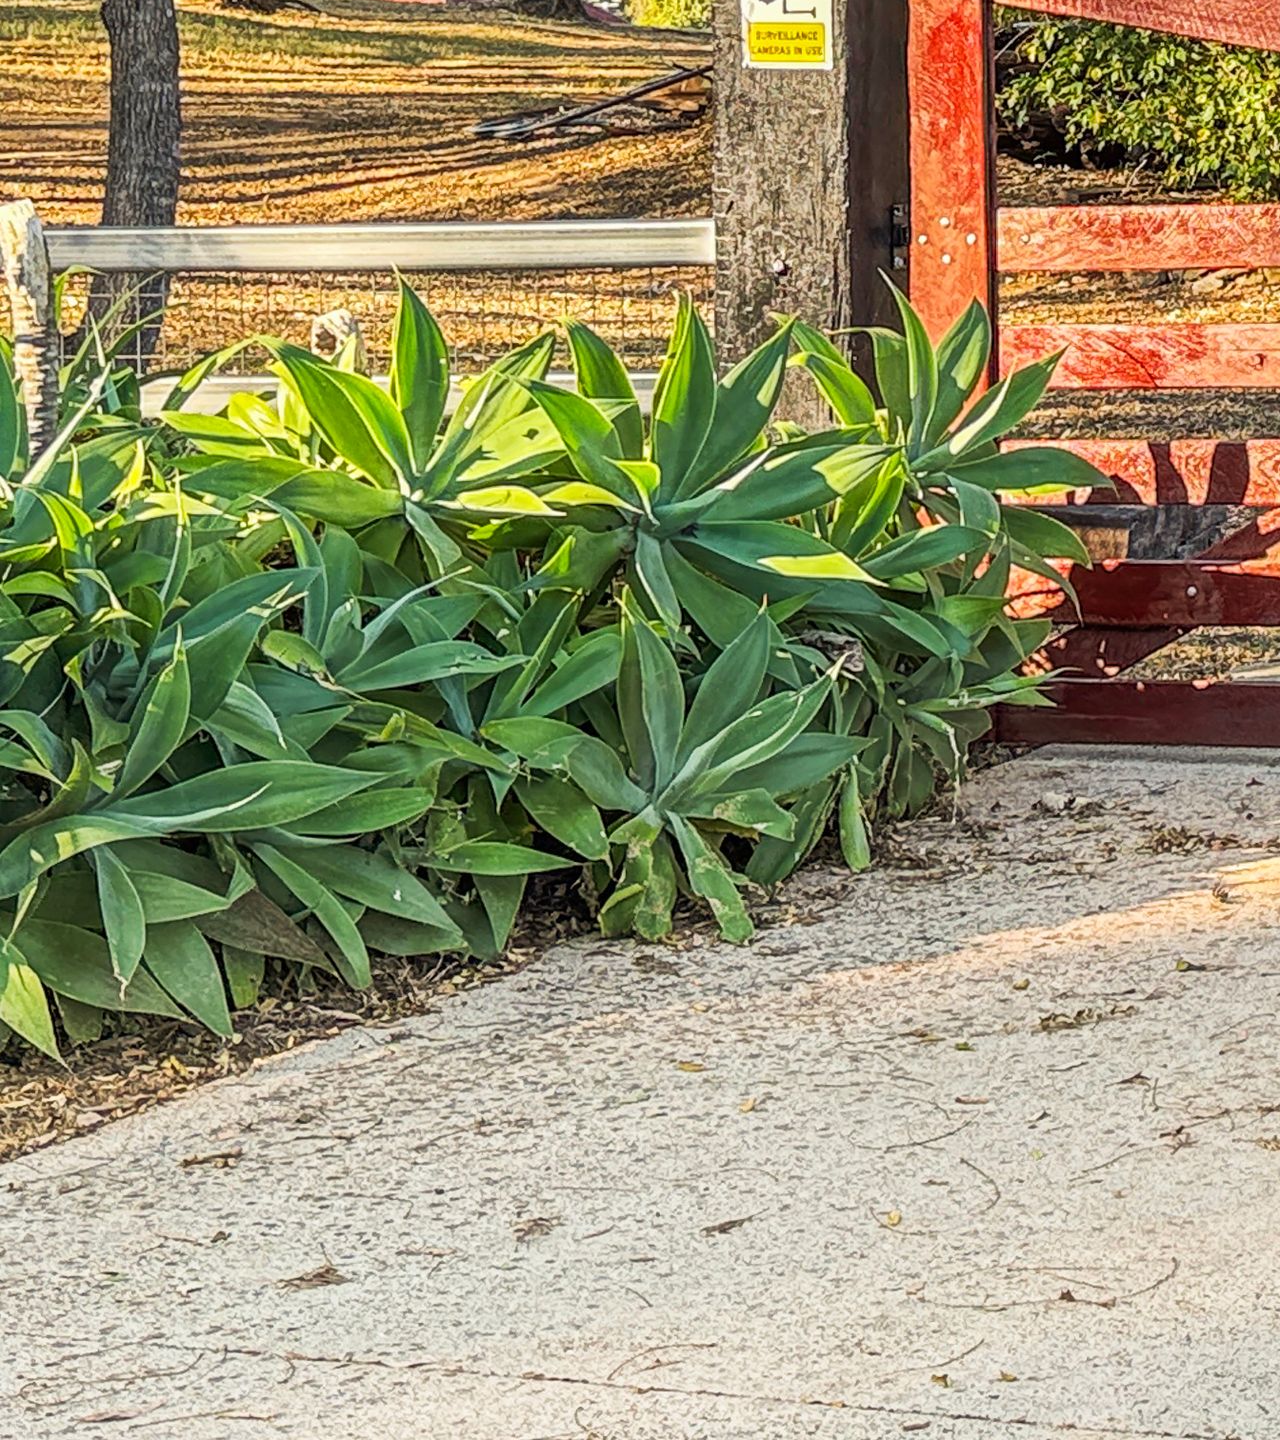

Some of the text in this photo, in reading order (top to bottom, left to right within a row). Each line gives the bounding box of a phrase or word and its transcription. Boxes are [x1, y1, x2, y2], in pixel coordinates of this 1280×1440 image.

[755, 31, 819, 40] SURVEILLANCE
[751, 46, 823, 56] CAMERAS IN USE
